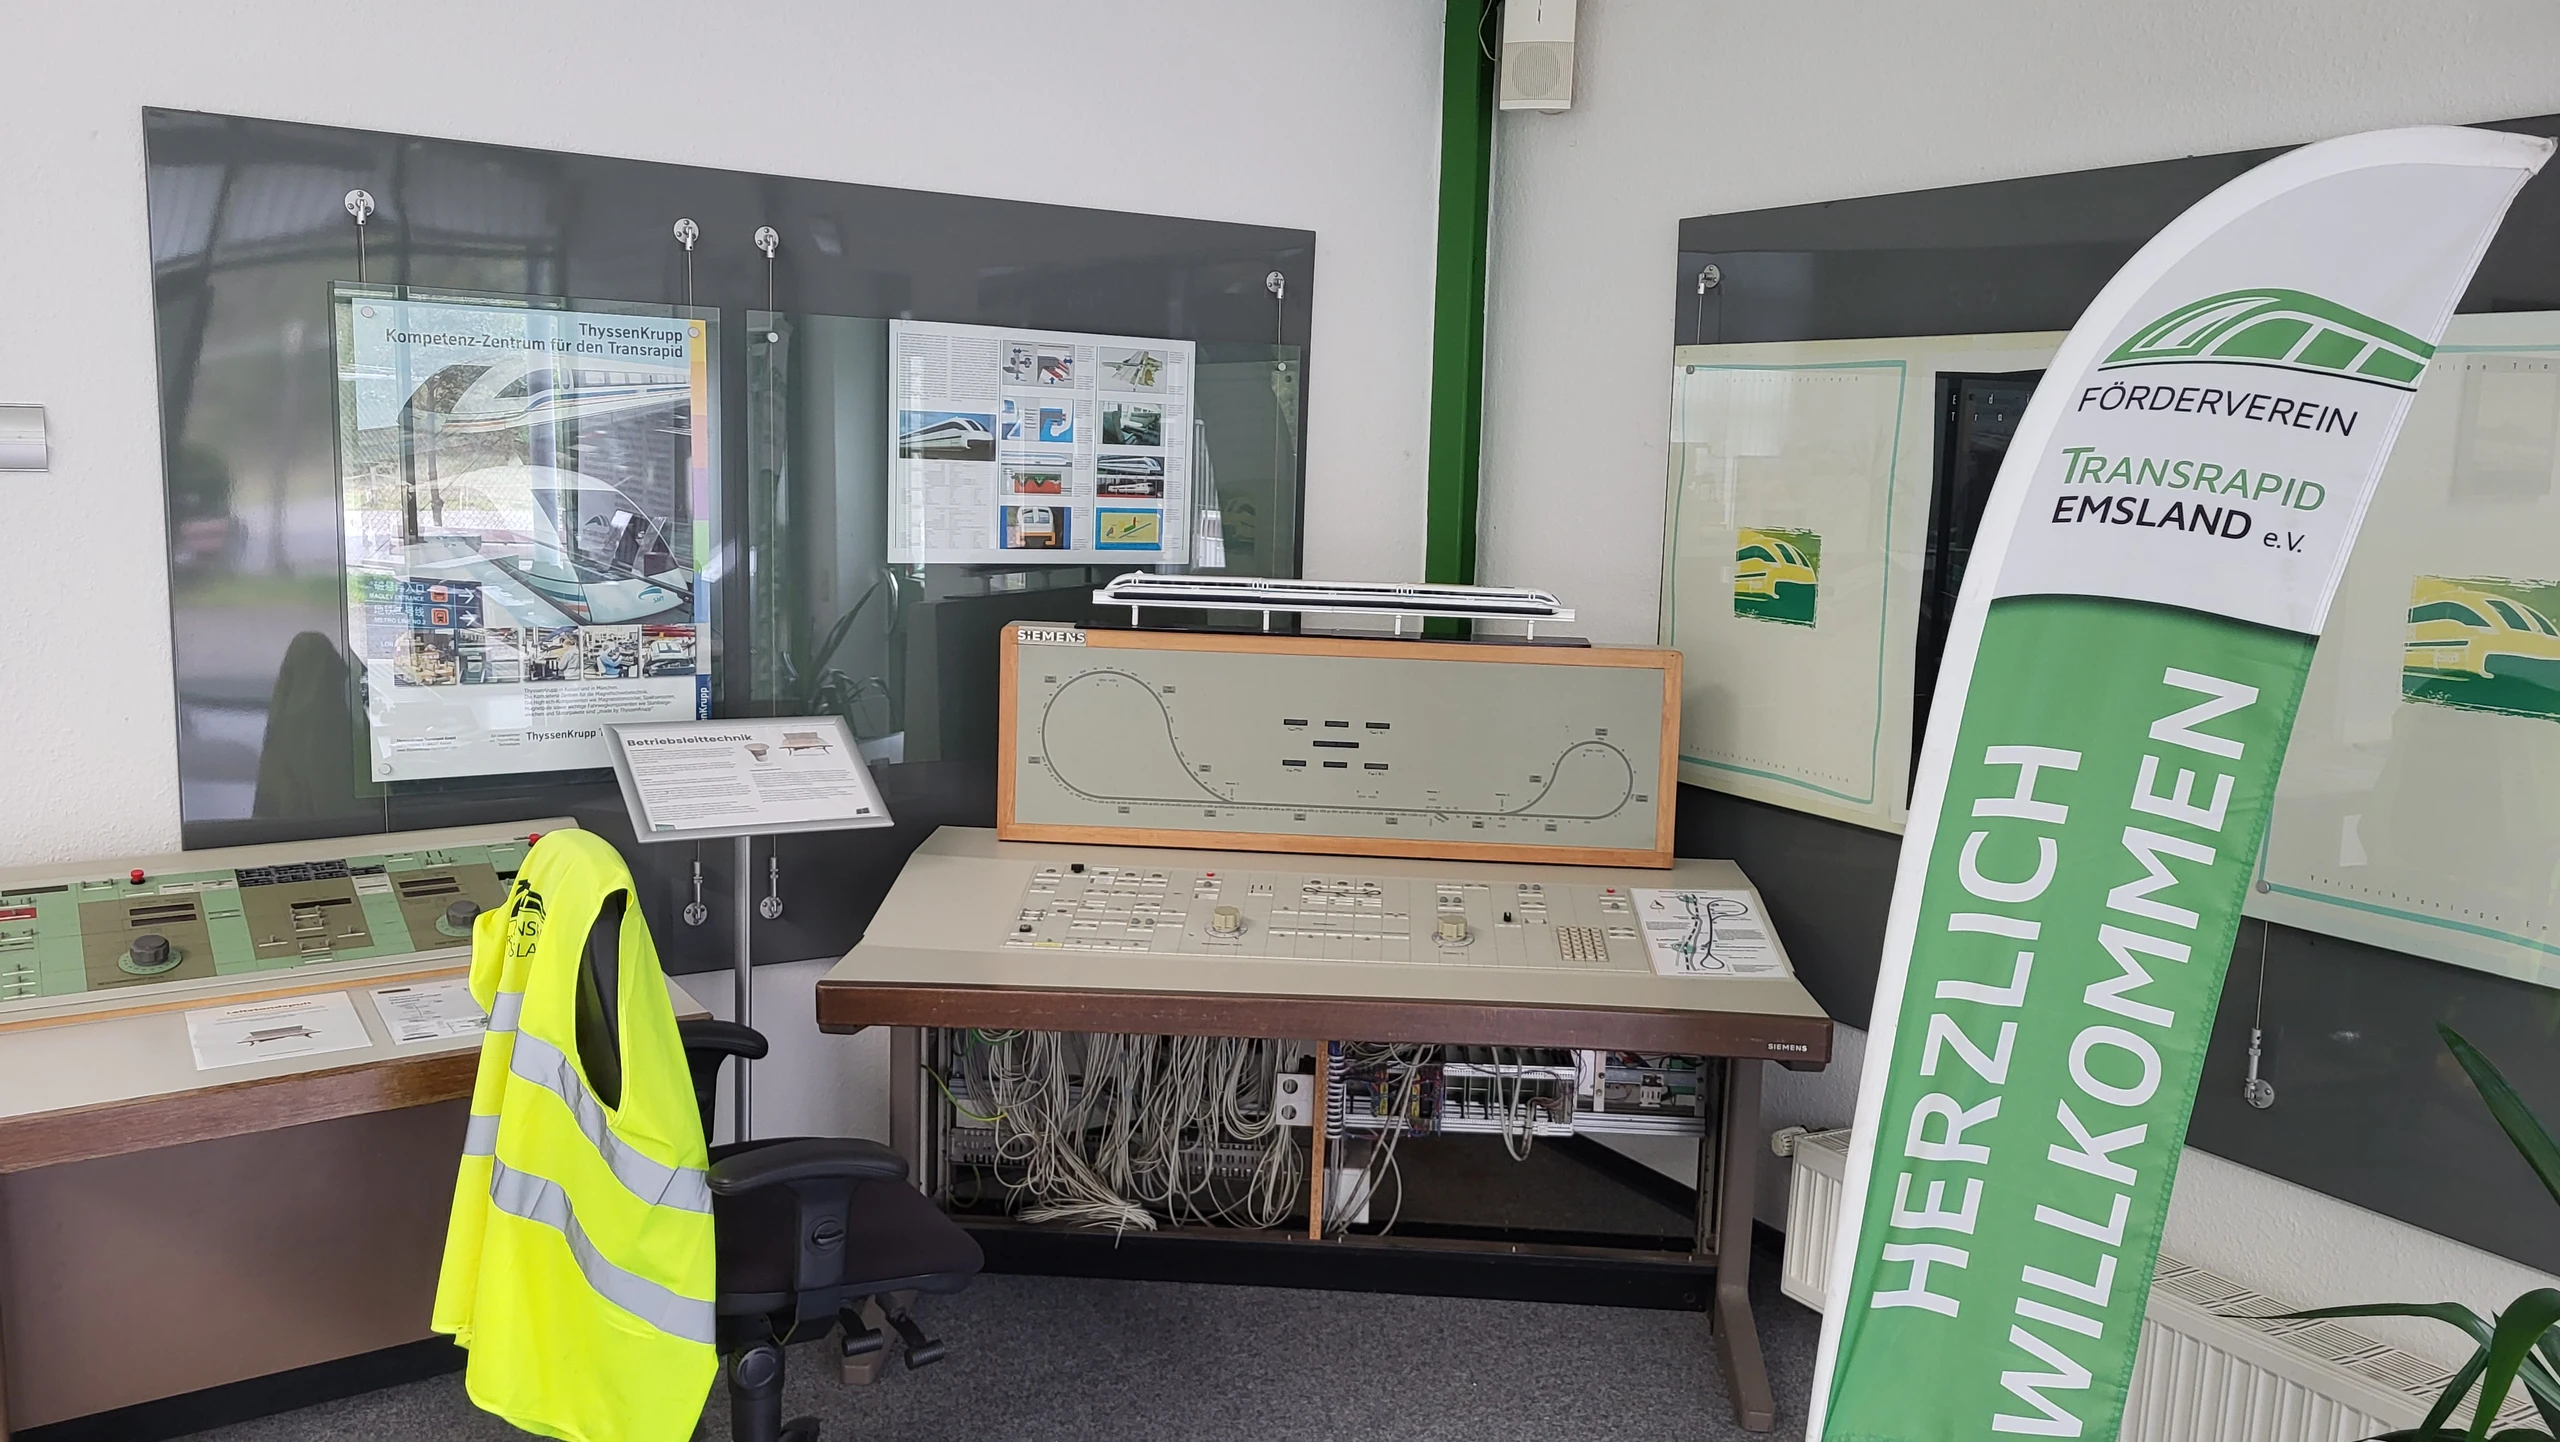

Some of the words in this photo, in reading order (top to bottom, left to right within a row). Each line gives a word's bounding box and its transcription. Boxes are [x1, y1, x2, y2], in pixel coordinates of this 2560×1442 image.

[385, 328, 546, 352] Kompetenz-Zentrum
[550, 337, 572, 352] für
[576, 340, 604, 355] den
[609, 341, 684, 359] Transrapid
[578, 322, 683, 343] ThyssenKrupp
[2077, 381, 2358, 437] FÖRDERVEREIN
[2051, 495, 2253, 540] EMSLAND
[1017, 629, 1086, 643] SIEMENS
[525, 729, 597, 742] ThyssenKrupp
[627, 734, 754, 747] Betriebsleittechnik
[1869, 744, 2084, 1319] HERZLICH
[1767, 1043, 1808, 1052] SIEMENS
[1992, 665, 2260, 1439] WILLKOMMEN
